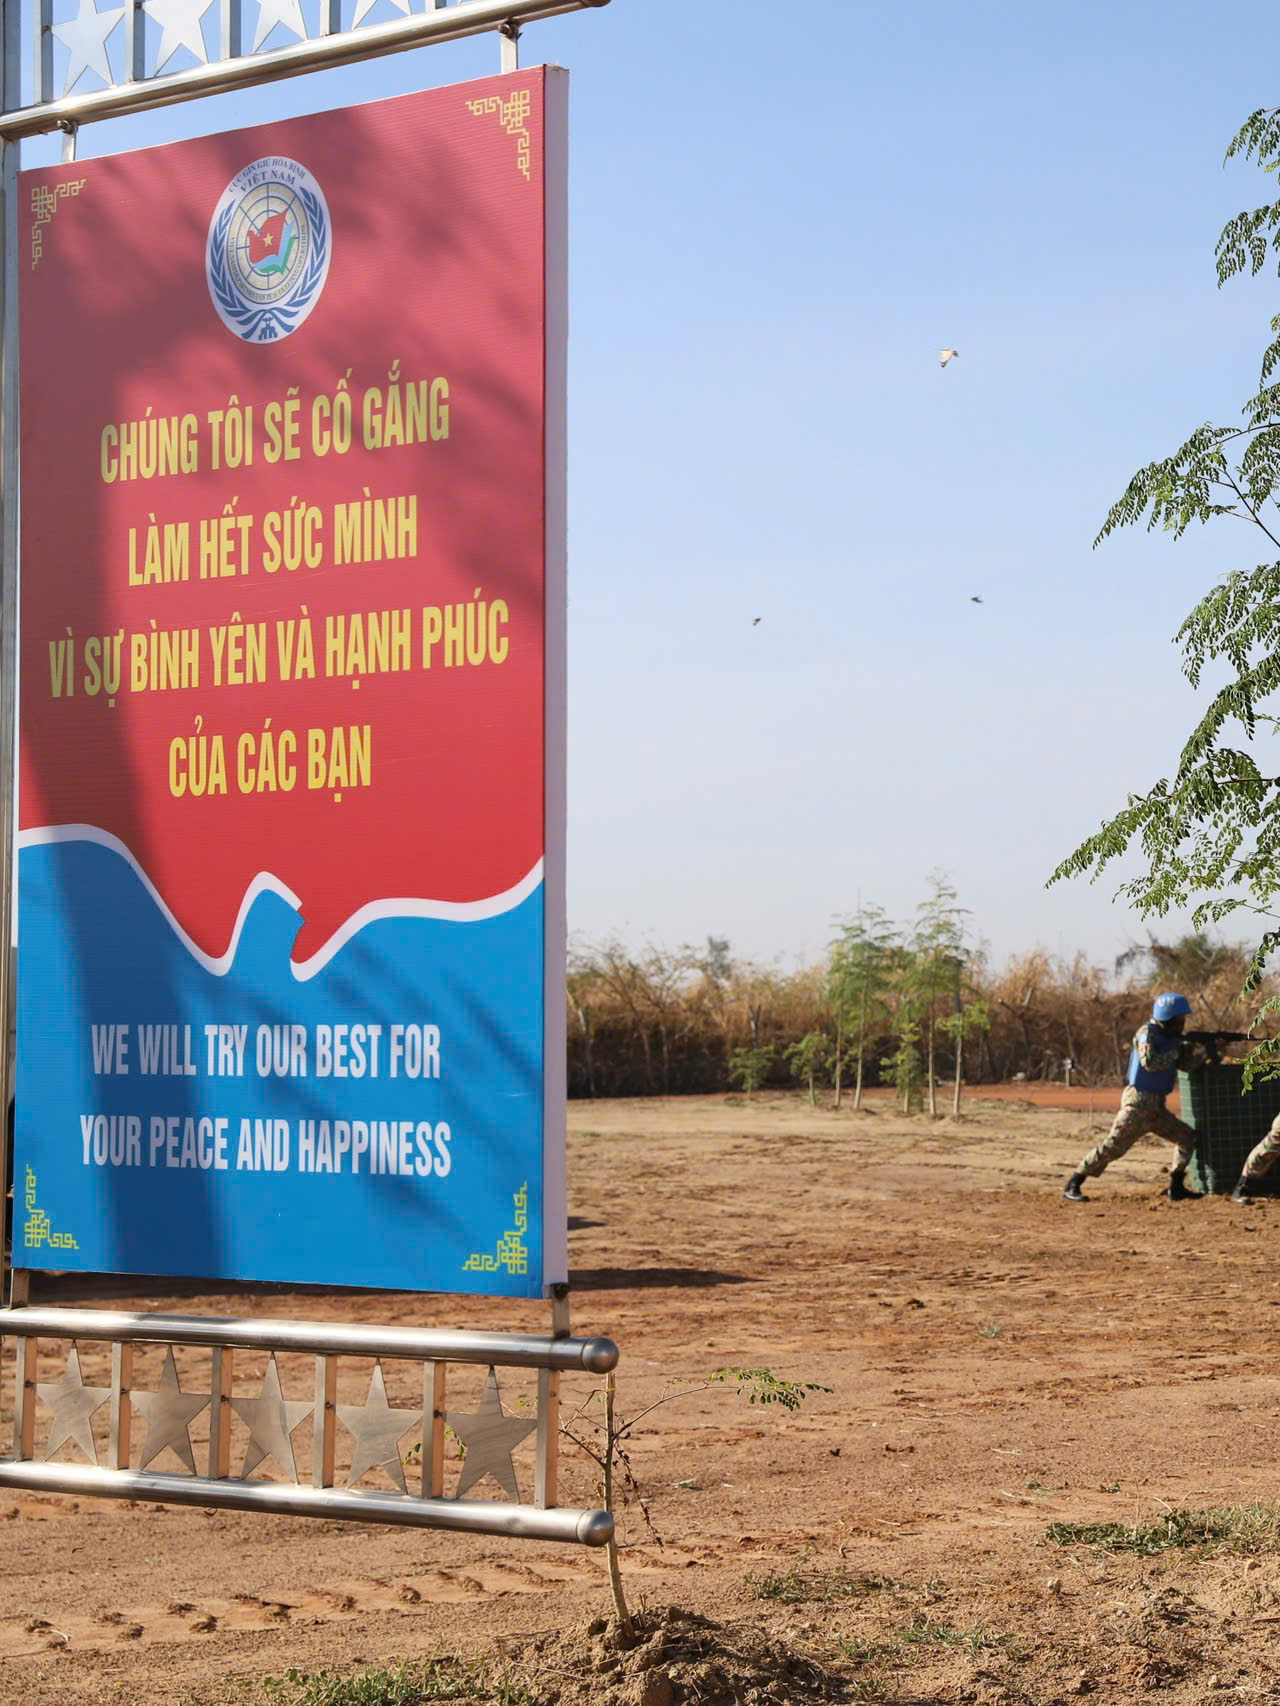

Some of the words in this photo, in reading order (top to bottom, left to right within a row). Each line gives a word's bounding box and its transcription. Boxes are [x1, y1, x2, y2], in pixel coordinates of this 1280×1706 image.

[270, 169, 296, 185] NAM
[101, 406, 198, 484] CHÚNG
[207, 394, 253, 471] TÔI
[263, 387, 302, 464] SẼ
[311, 368, 352, 457] CỐ
[362, 359, 451, 450] GẮNG
[127, 512, 190, 587] LÀM
[200, 496, 253, 580] HẾT
[262, 495, 323, 574] SỨC
[333, 486, 418, 566] MÌNH
[47, 627, 75, 698] VÌ
[83, 628, 124, 708] SỰ
[129, 618, 200, 694] BÌNH
[208, 612, 268, 687] YÊN
[276, 604, 316, 682] VÀ
[325, 608, 411, 690] HẠNH
[422, 587, 510, 670] PHÚC
[168, 715, 228, 798] CỦA
[237, 717, 298, 795] CÁC
[307, 724, 373, 803] BẠN
[91, 1023, 129, 1075] WE
[137, 1023, 197, 1076] WILL
[204, 1024, 249, 1077] TRY
[256, 1024, 308, 1078] OUR
[315, 1024, 383, 1078] BEST
[389, 1023, 441, 1080] FOR
[80, 1114, 142, 1168] YOUR
[148, 1116, 229, 1170] PEACE
[236, 1118, 290, 1173] AND
[298, 1119, 452, 1179] HAPPINESS
